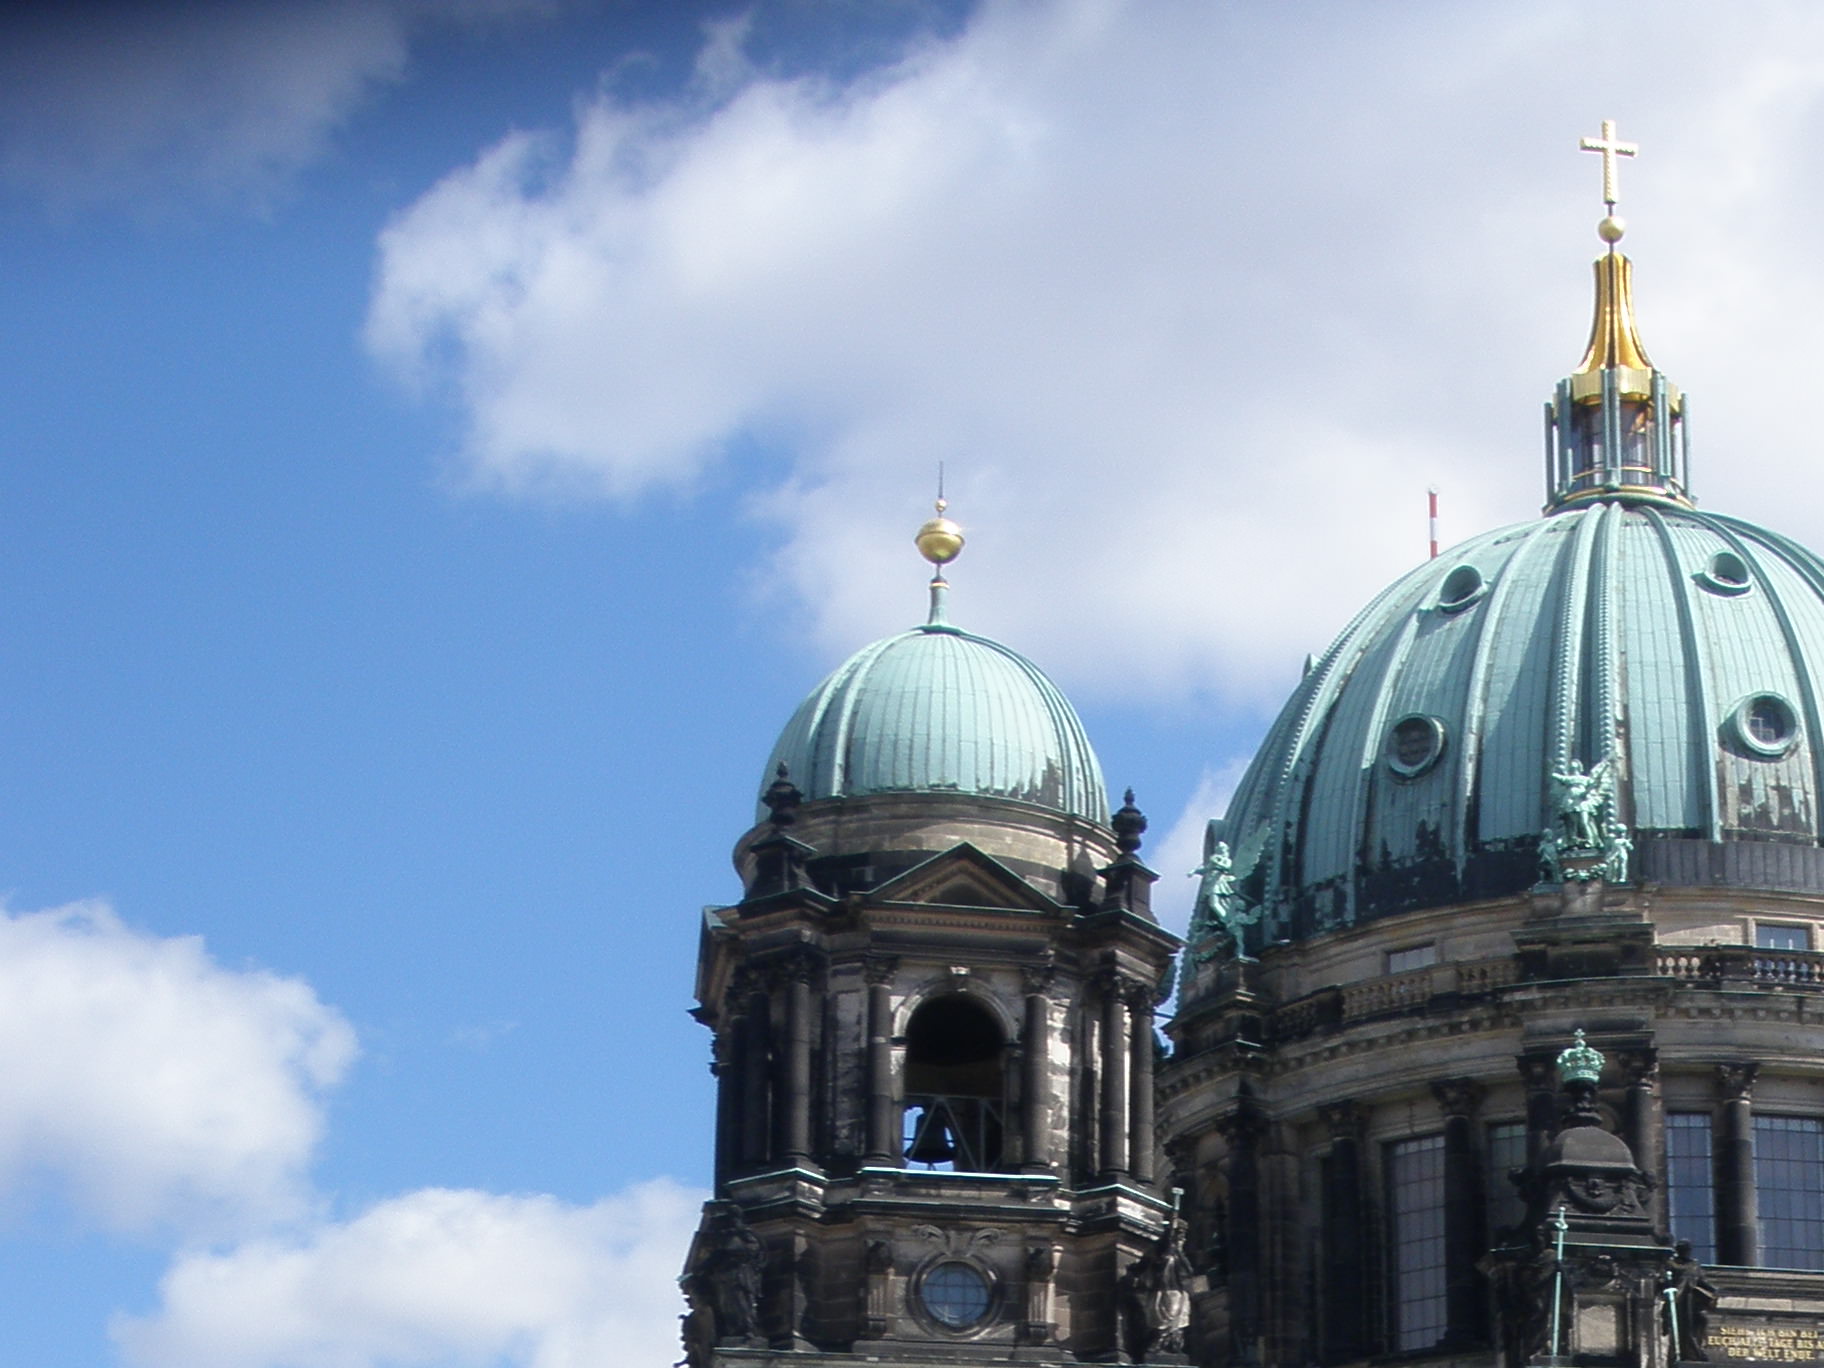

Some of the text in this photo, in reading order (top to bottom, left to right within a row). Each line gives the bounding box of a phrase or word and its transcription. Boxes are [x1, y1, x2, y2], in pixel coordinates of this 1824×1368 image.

[1778, 1329, 1797, 1338] BIN
[1800, 1330, 1818, 1339] BEI
[1708, 1336, 1737, 1346] EUCH
[1769, 1338, 1794, 1348] TAGE
[1797, 1340, 1814, 1349] BIS
[1728, 1347, 1749, 1357] DER
[1752, 1347, 1780, 1358] WELT
